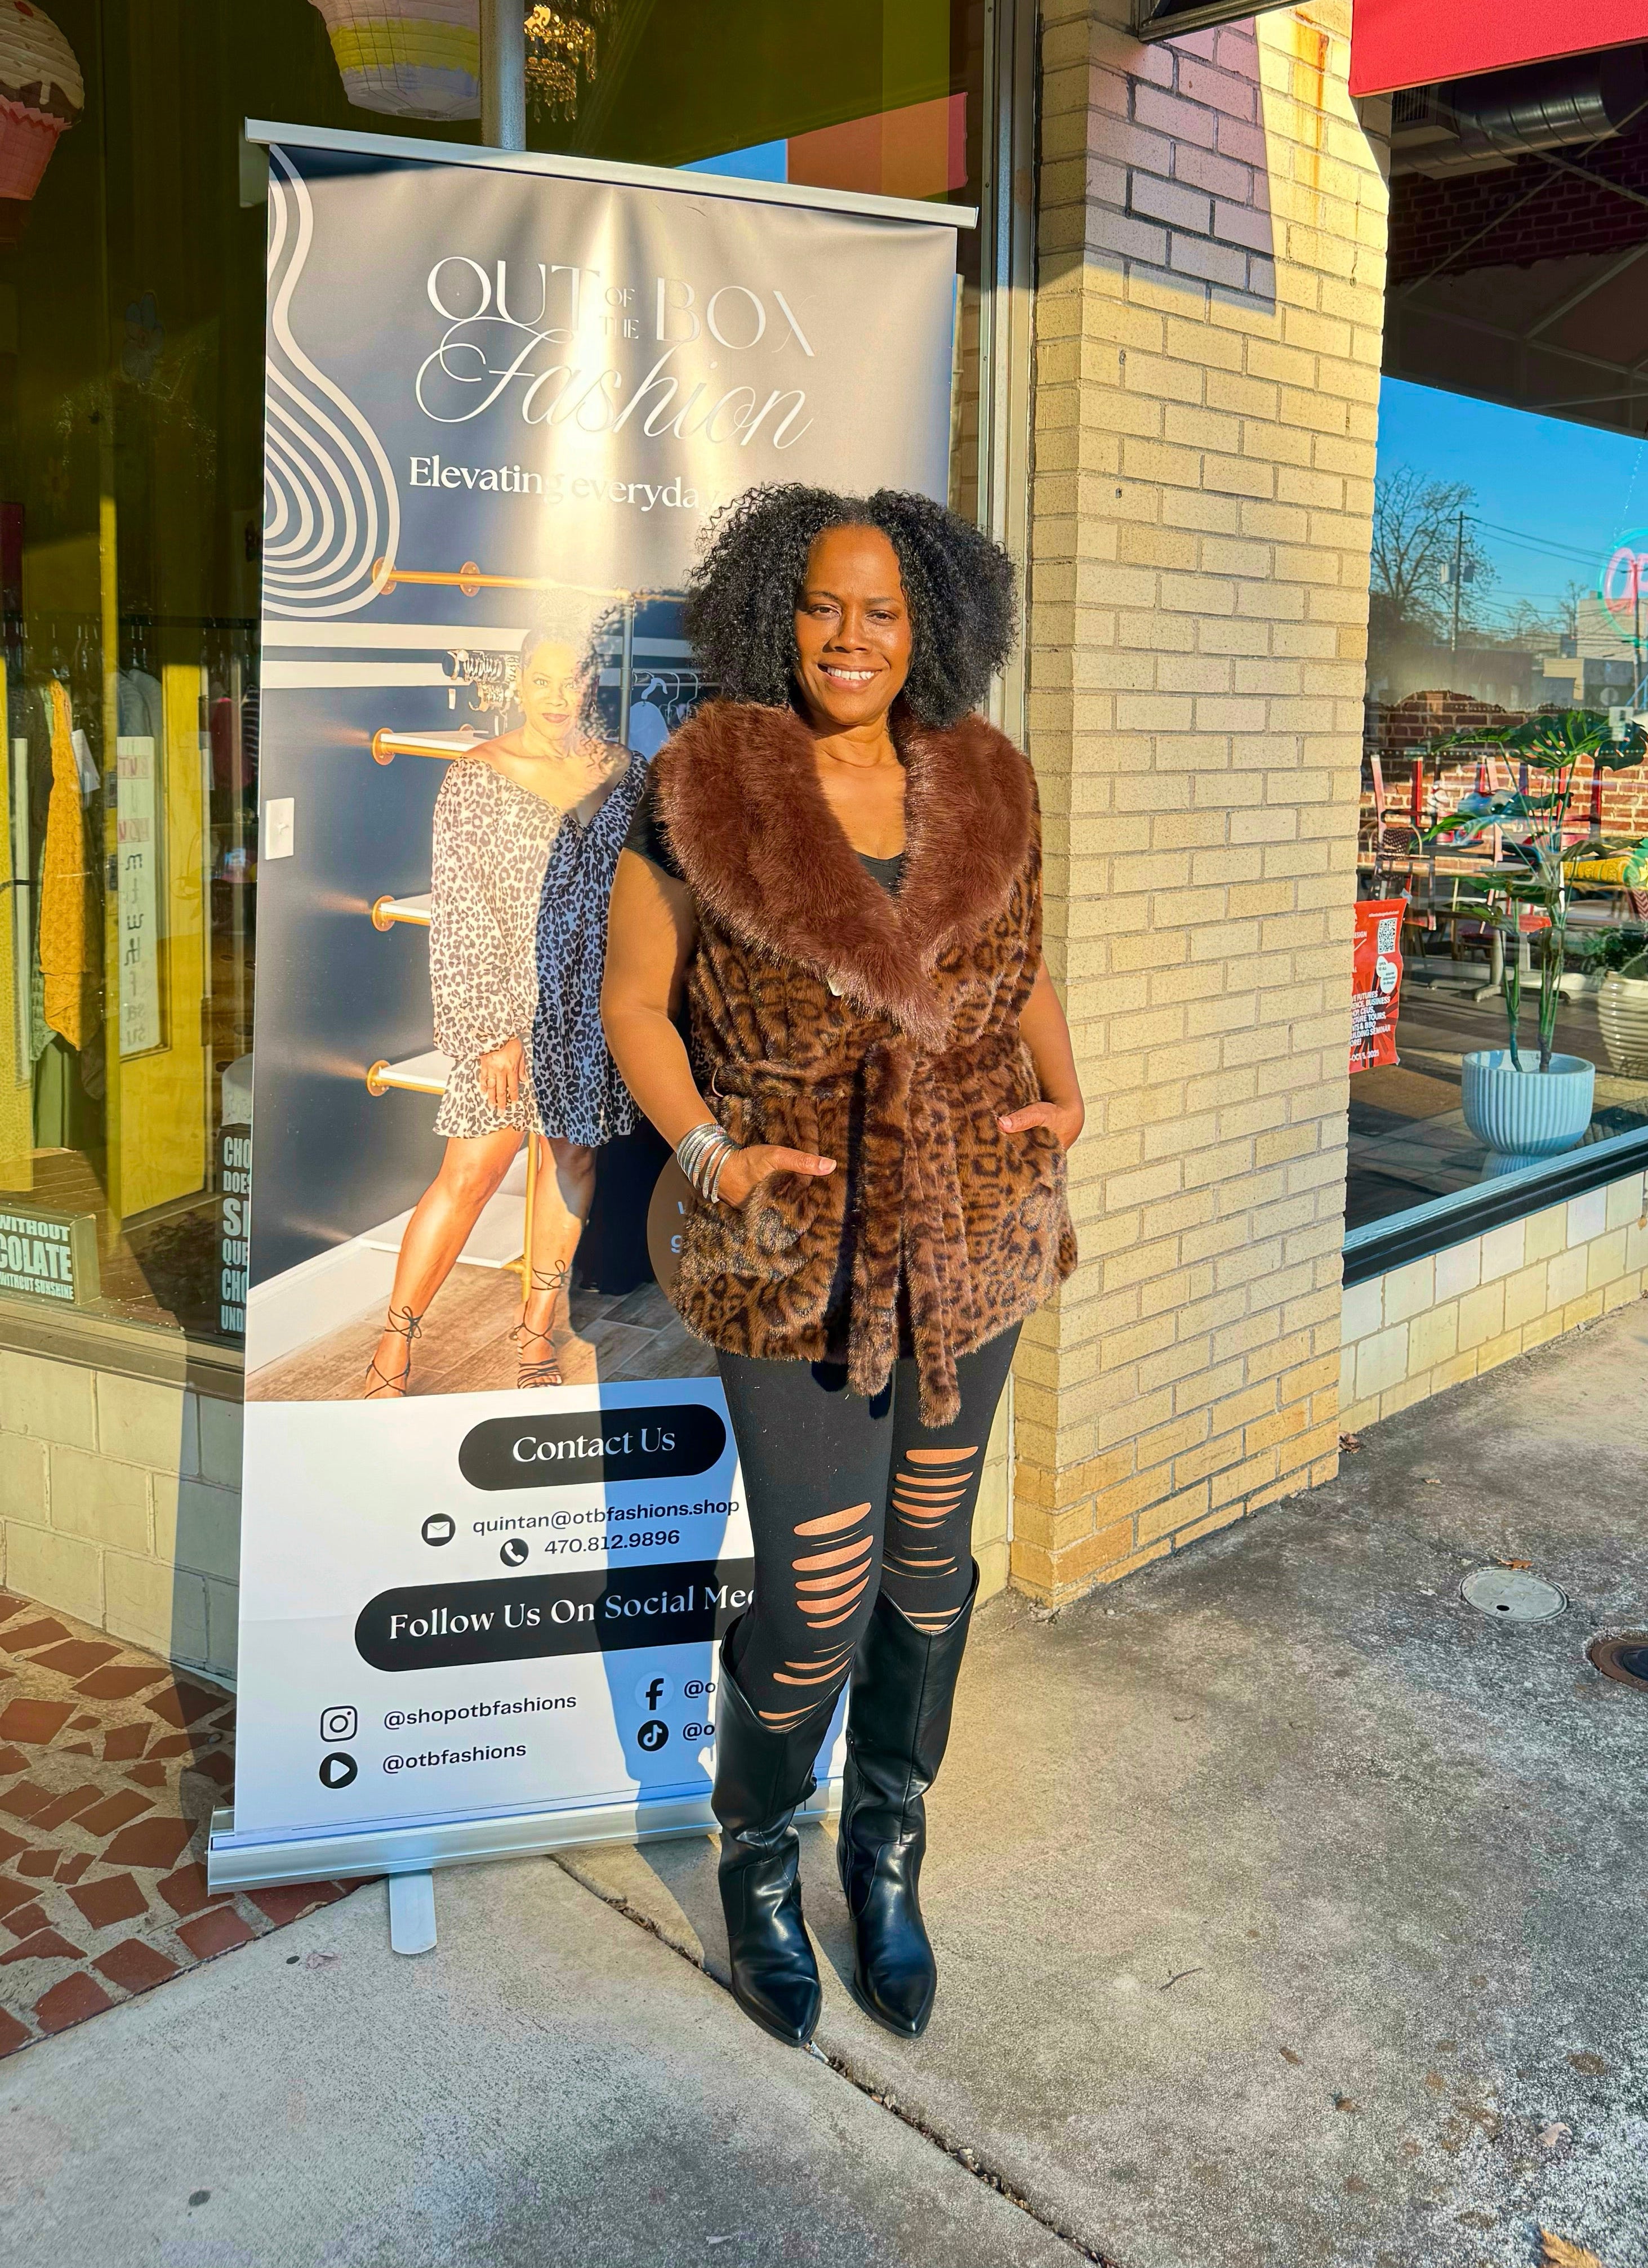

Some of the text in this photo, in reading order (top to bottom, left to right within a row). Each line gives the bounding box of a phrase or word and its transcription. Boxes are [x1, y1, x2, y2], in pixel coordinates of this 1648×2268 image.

[427, 256, 817, 358] OUT OF THE BOX
[415, 316, 814, 449] Fashion
[409, 454, 565, 504] Elevating
[0, 1215, 70, 1242] WITHOUT
[35, 1279, 74, 1300] SUNSHINE
[512, 1427, 675, 1462] Contact Us
[472, 1499, 740, 1533] quintan@otbfashions.shop
[544, 1529, 680, 1555] 470.812.9896
[389, 1607, 495, 1639] Follow
[504, 1603, 541, 1628] Us
[550, 1599, 595, 1624] On
[605, 1585, 694, 1619] Social
[384, 1696, 577, 1730] @shopotbfashions
[382, 1744, 527, 1774] @otbfashions
